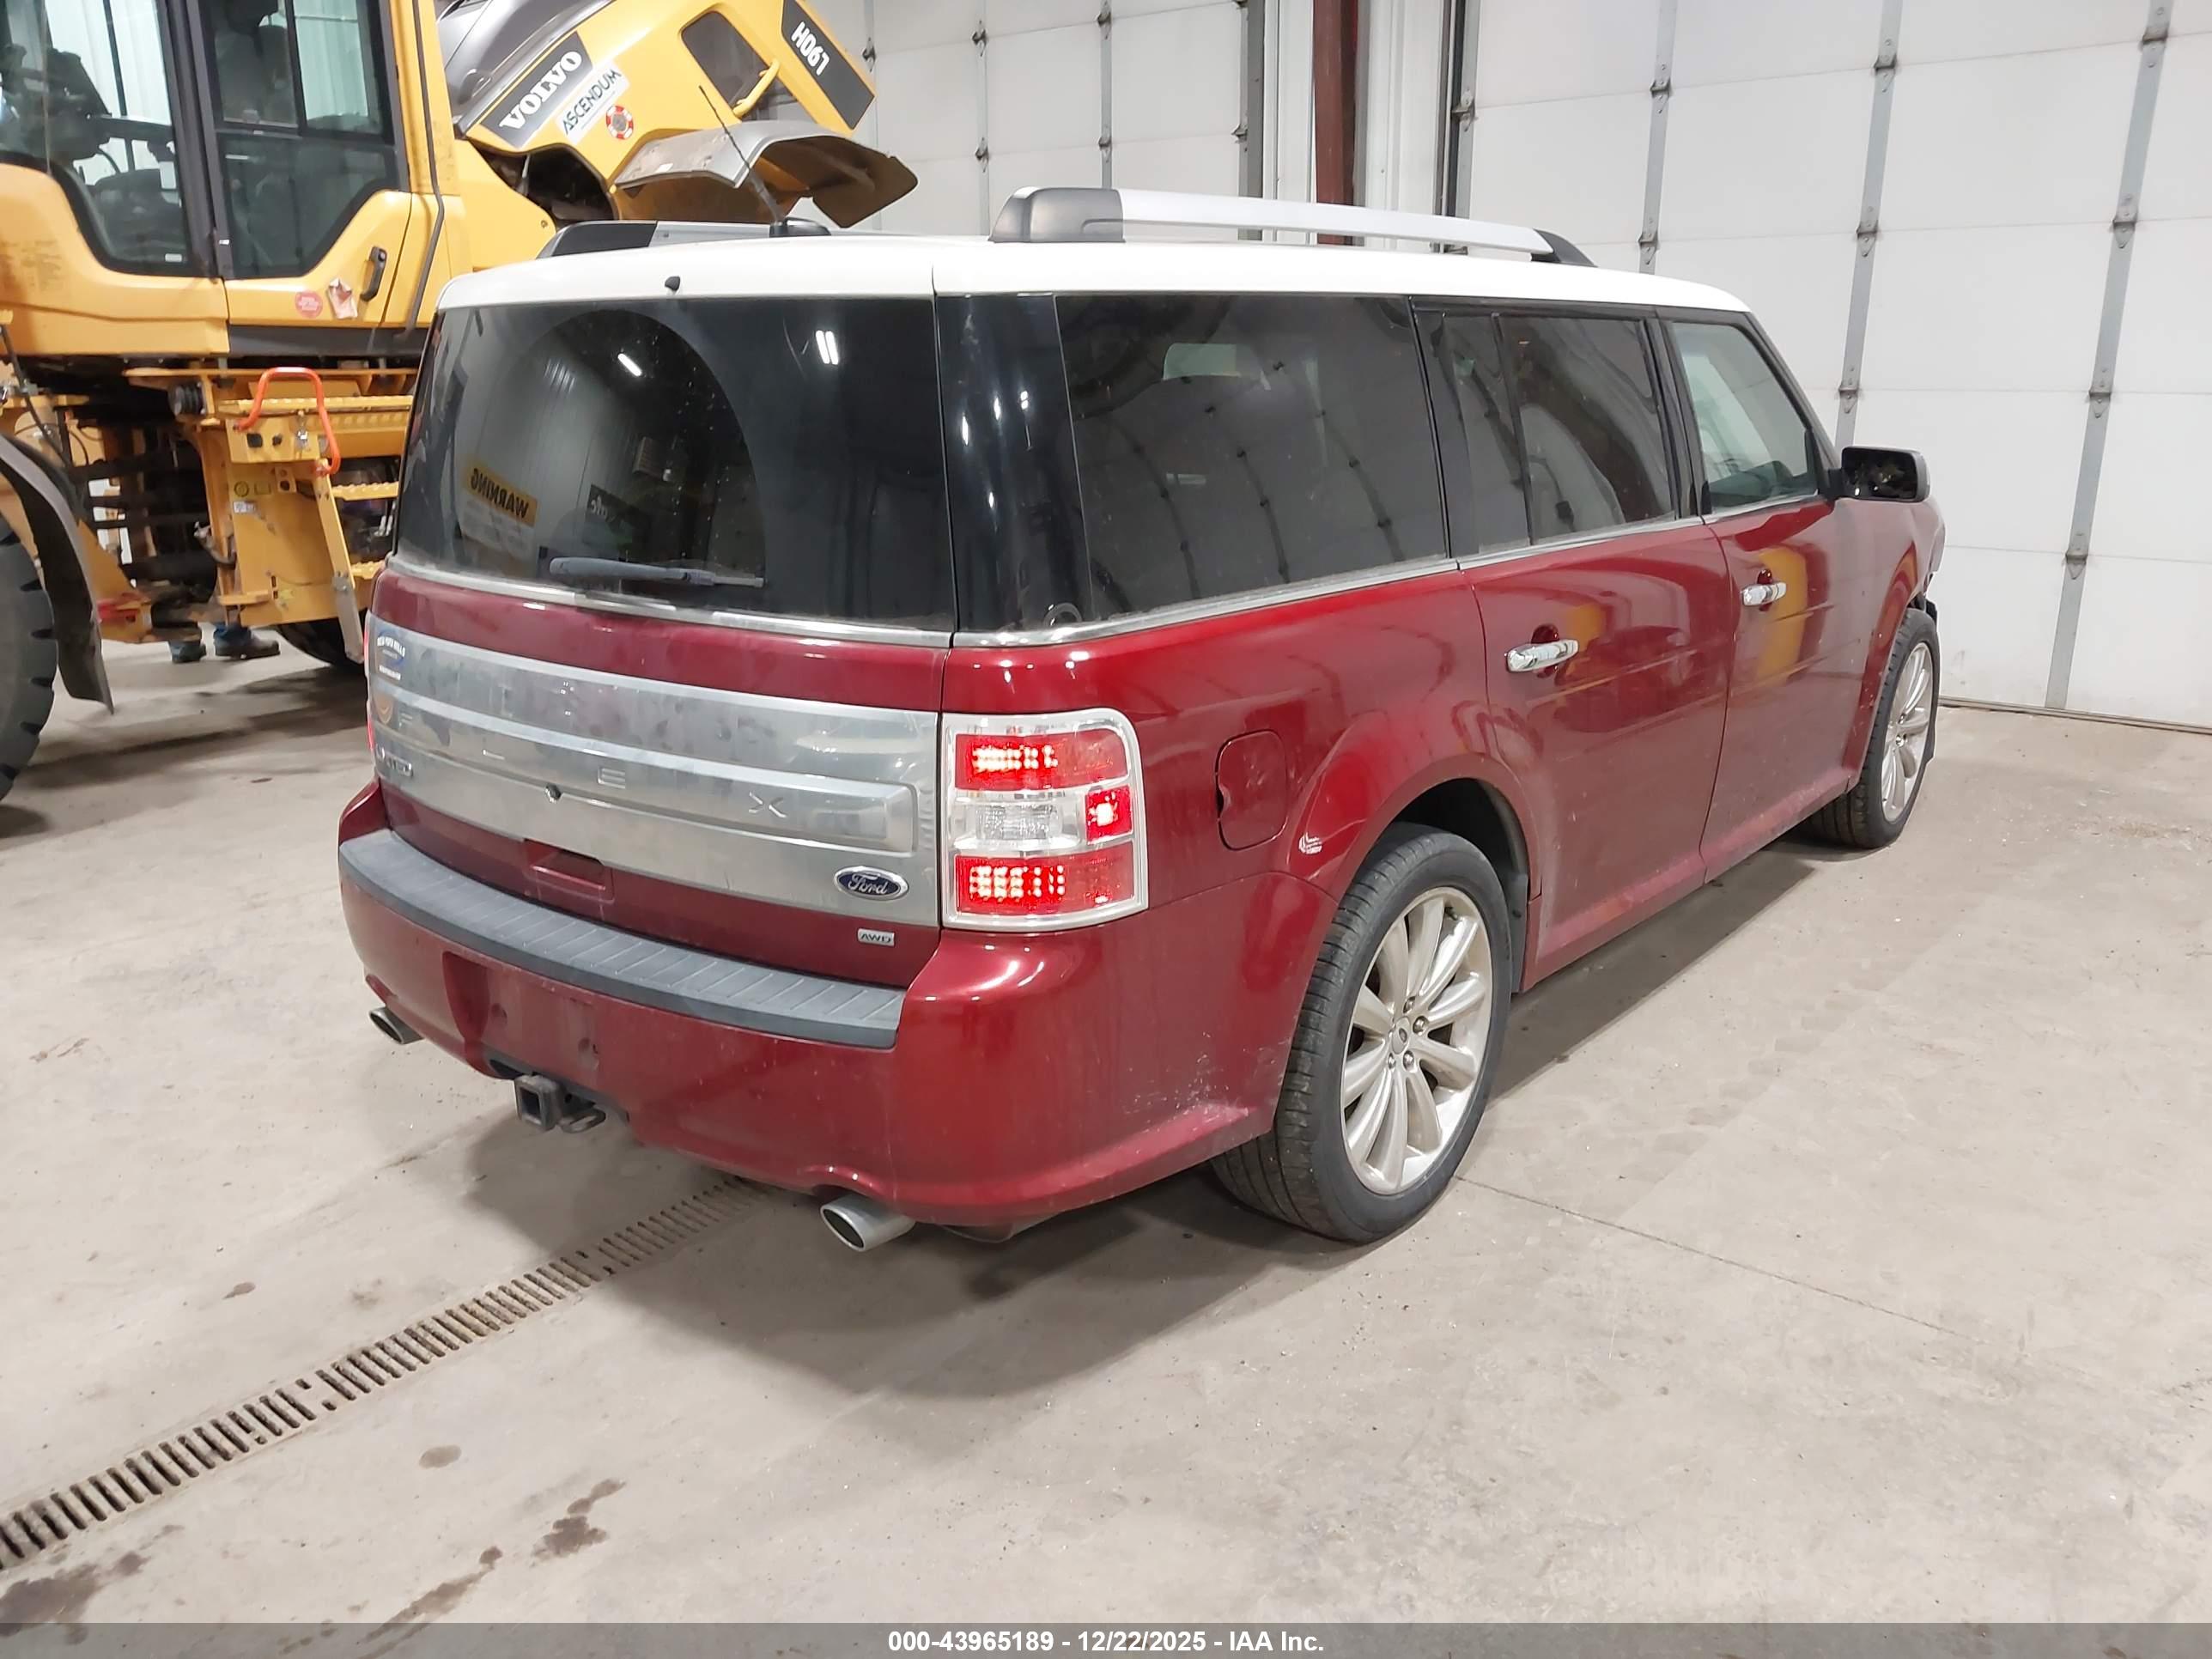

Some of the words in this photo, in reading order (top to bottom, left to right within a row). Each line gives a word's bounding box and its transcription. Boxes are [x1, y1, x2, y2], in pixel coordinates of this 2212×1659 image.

[498, 51, 583, 130] VOLVO
[562, 68, 623, 136] ASCENDUM
[847, 872, 890, 895] Ford
[860, 933, 891, 944] AWD
